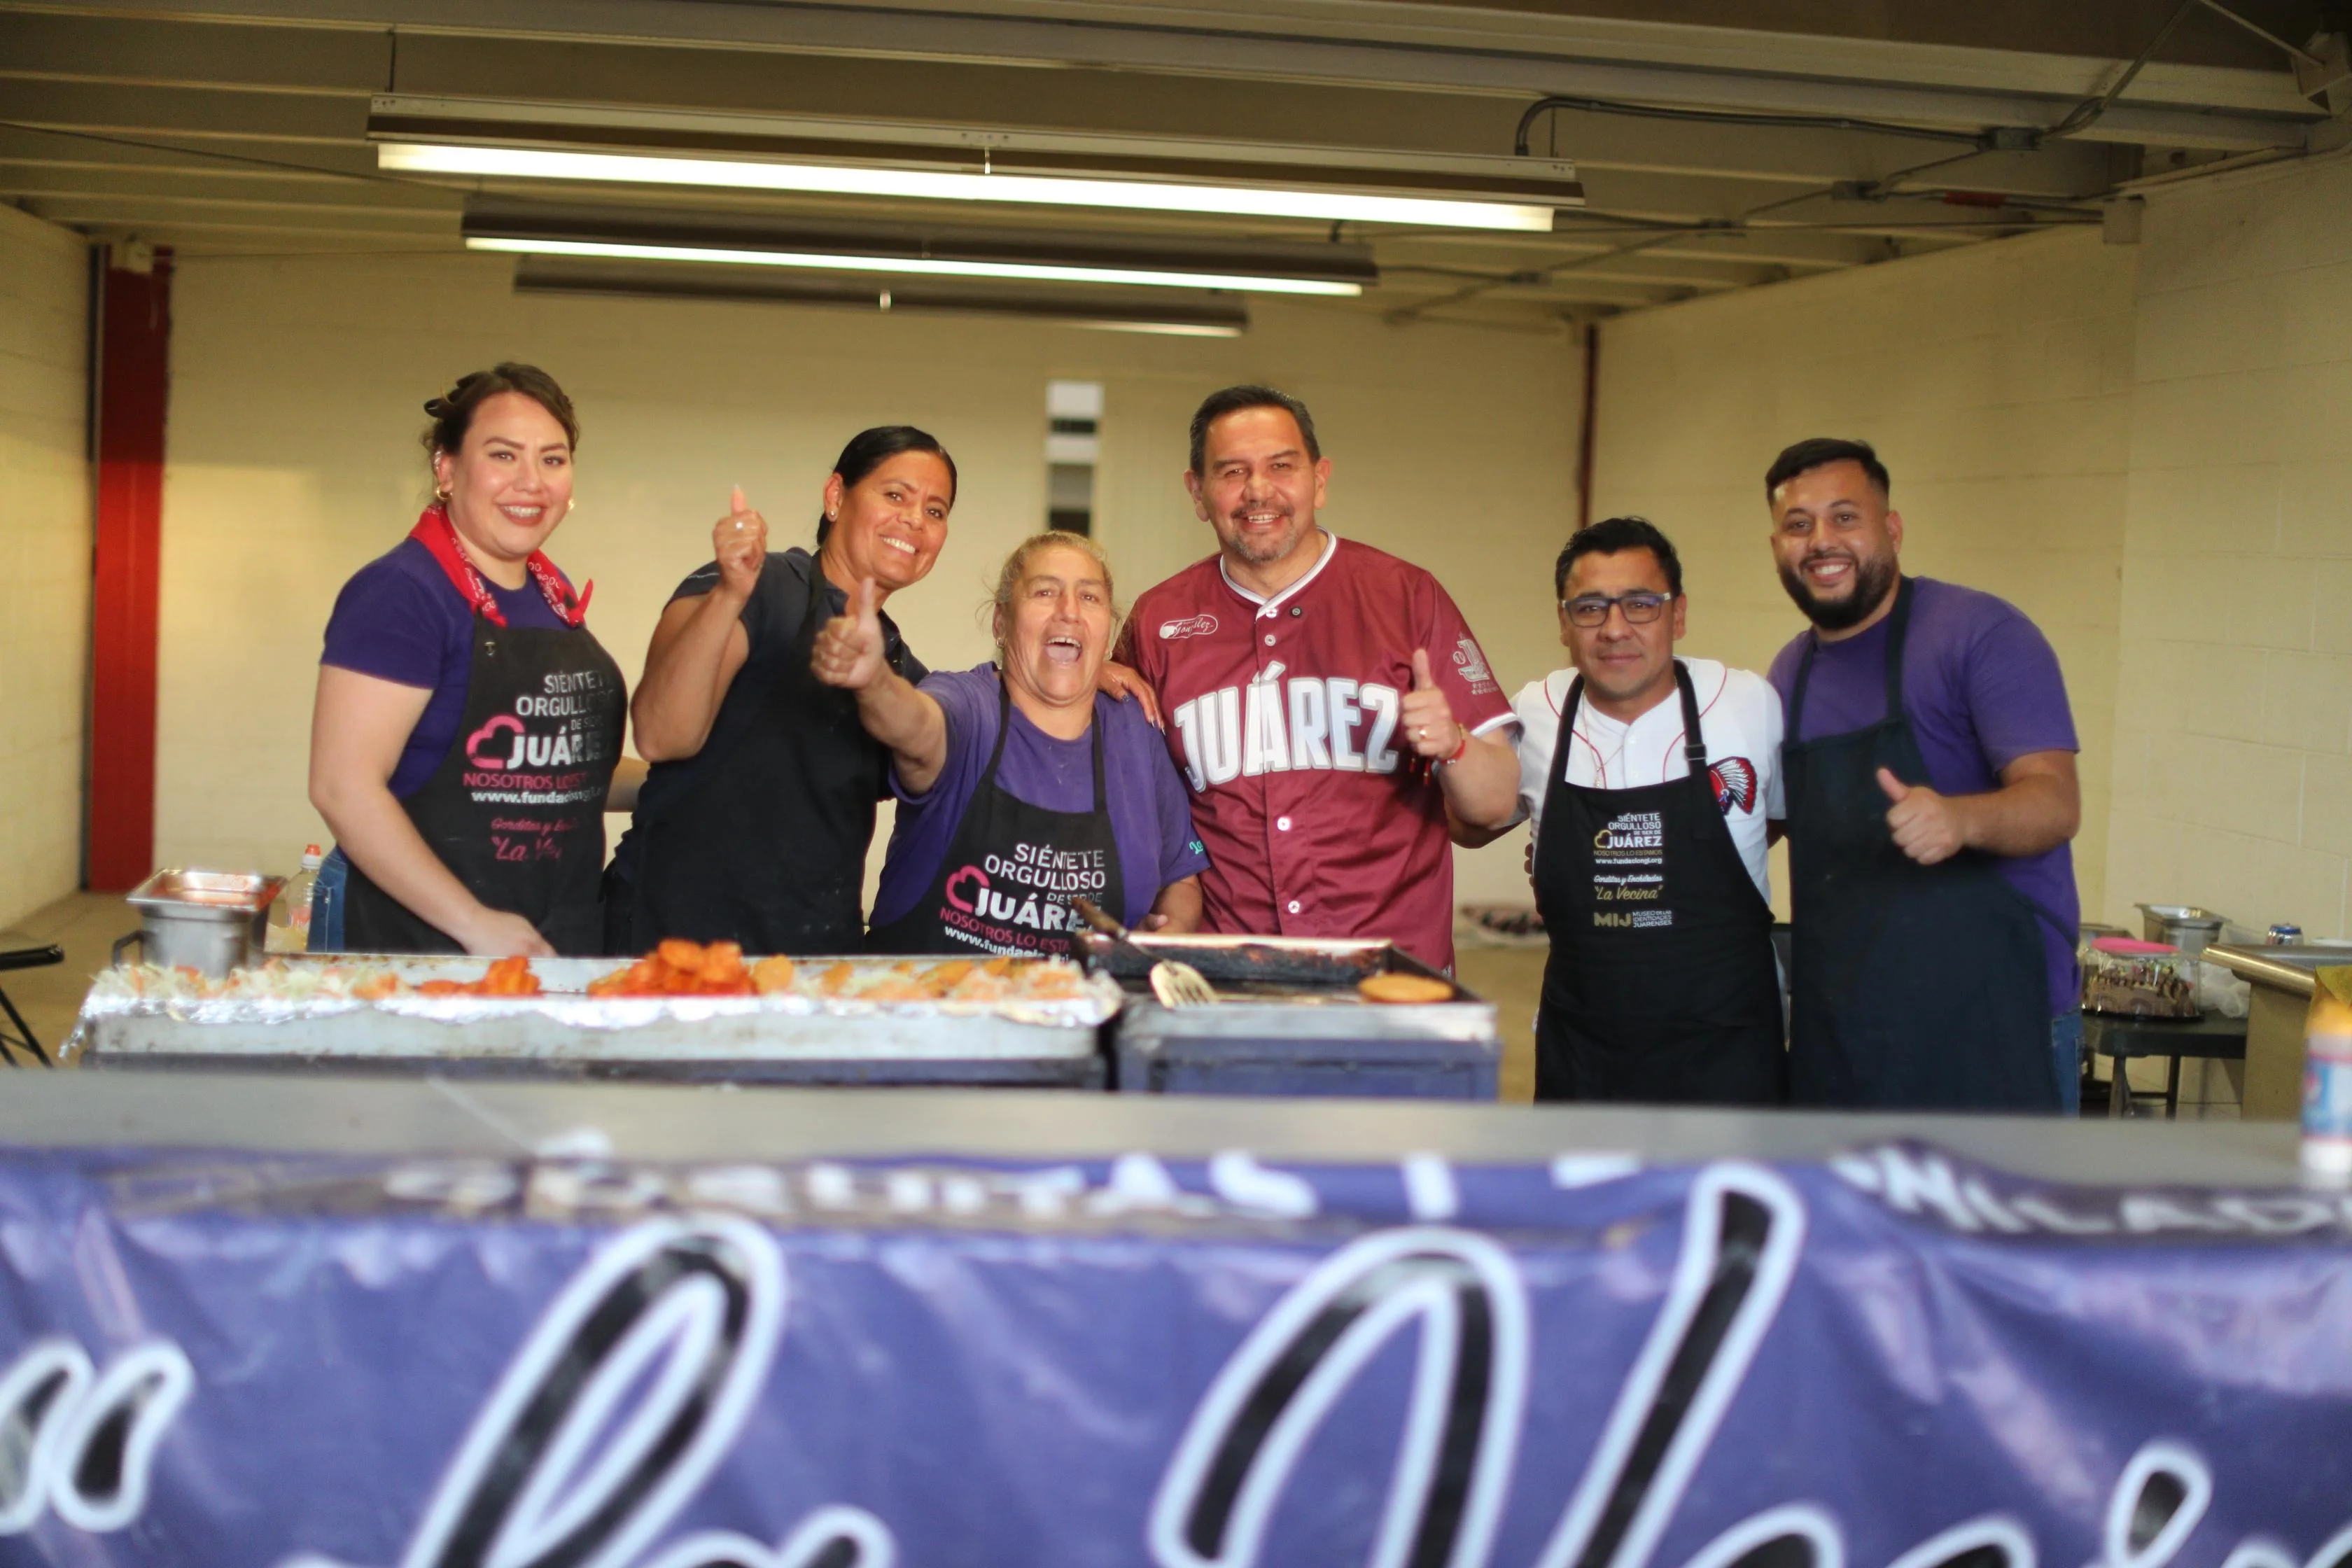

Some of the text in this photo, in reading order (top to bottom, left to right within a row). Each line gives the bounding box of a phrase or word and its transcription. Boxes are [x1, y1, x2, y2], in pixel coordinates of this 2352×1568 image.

[1174, 661, 1399, 792] JUÁREZ
[507, 726, 603, 769] JUÁRE
[463, 773, 552, 790] NOSOTROS
[1608, 820, 1661, 830] ORGULLOSO
[1618, 812, 1660, 822] SIÉNTETE
[1607, 833, 1662, 849] JUÁREZ
[1015, 843, 1105, 870] SIÉNTETE
[984, 854, 1105, 891] ORGULLOSO
[1046, 892, 1065, 905] DE
[975, 888, 1102, 934] JUÁRE
[1593, 912, 1632, 927] MIJ
[939, 907, 1070, 953] NOSOTROS LO ESTA
